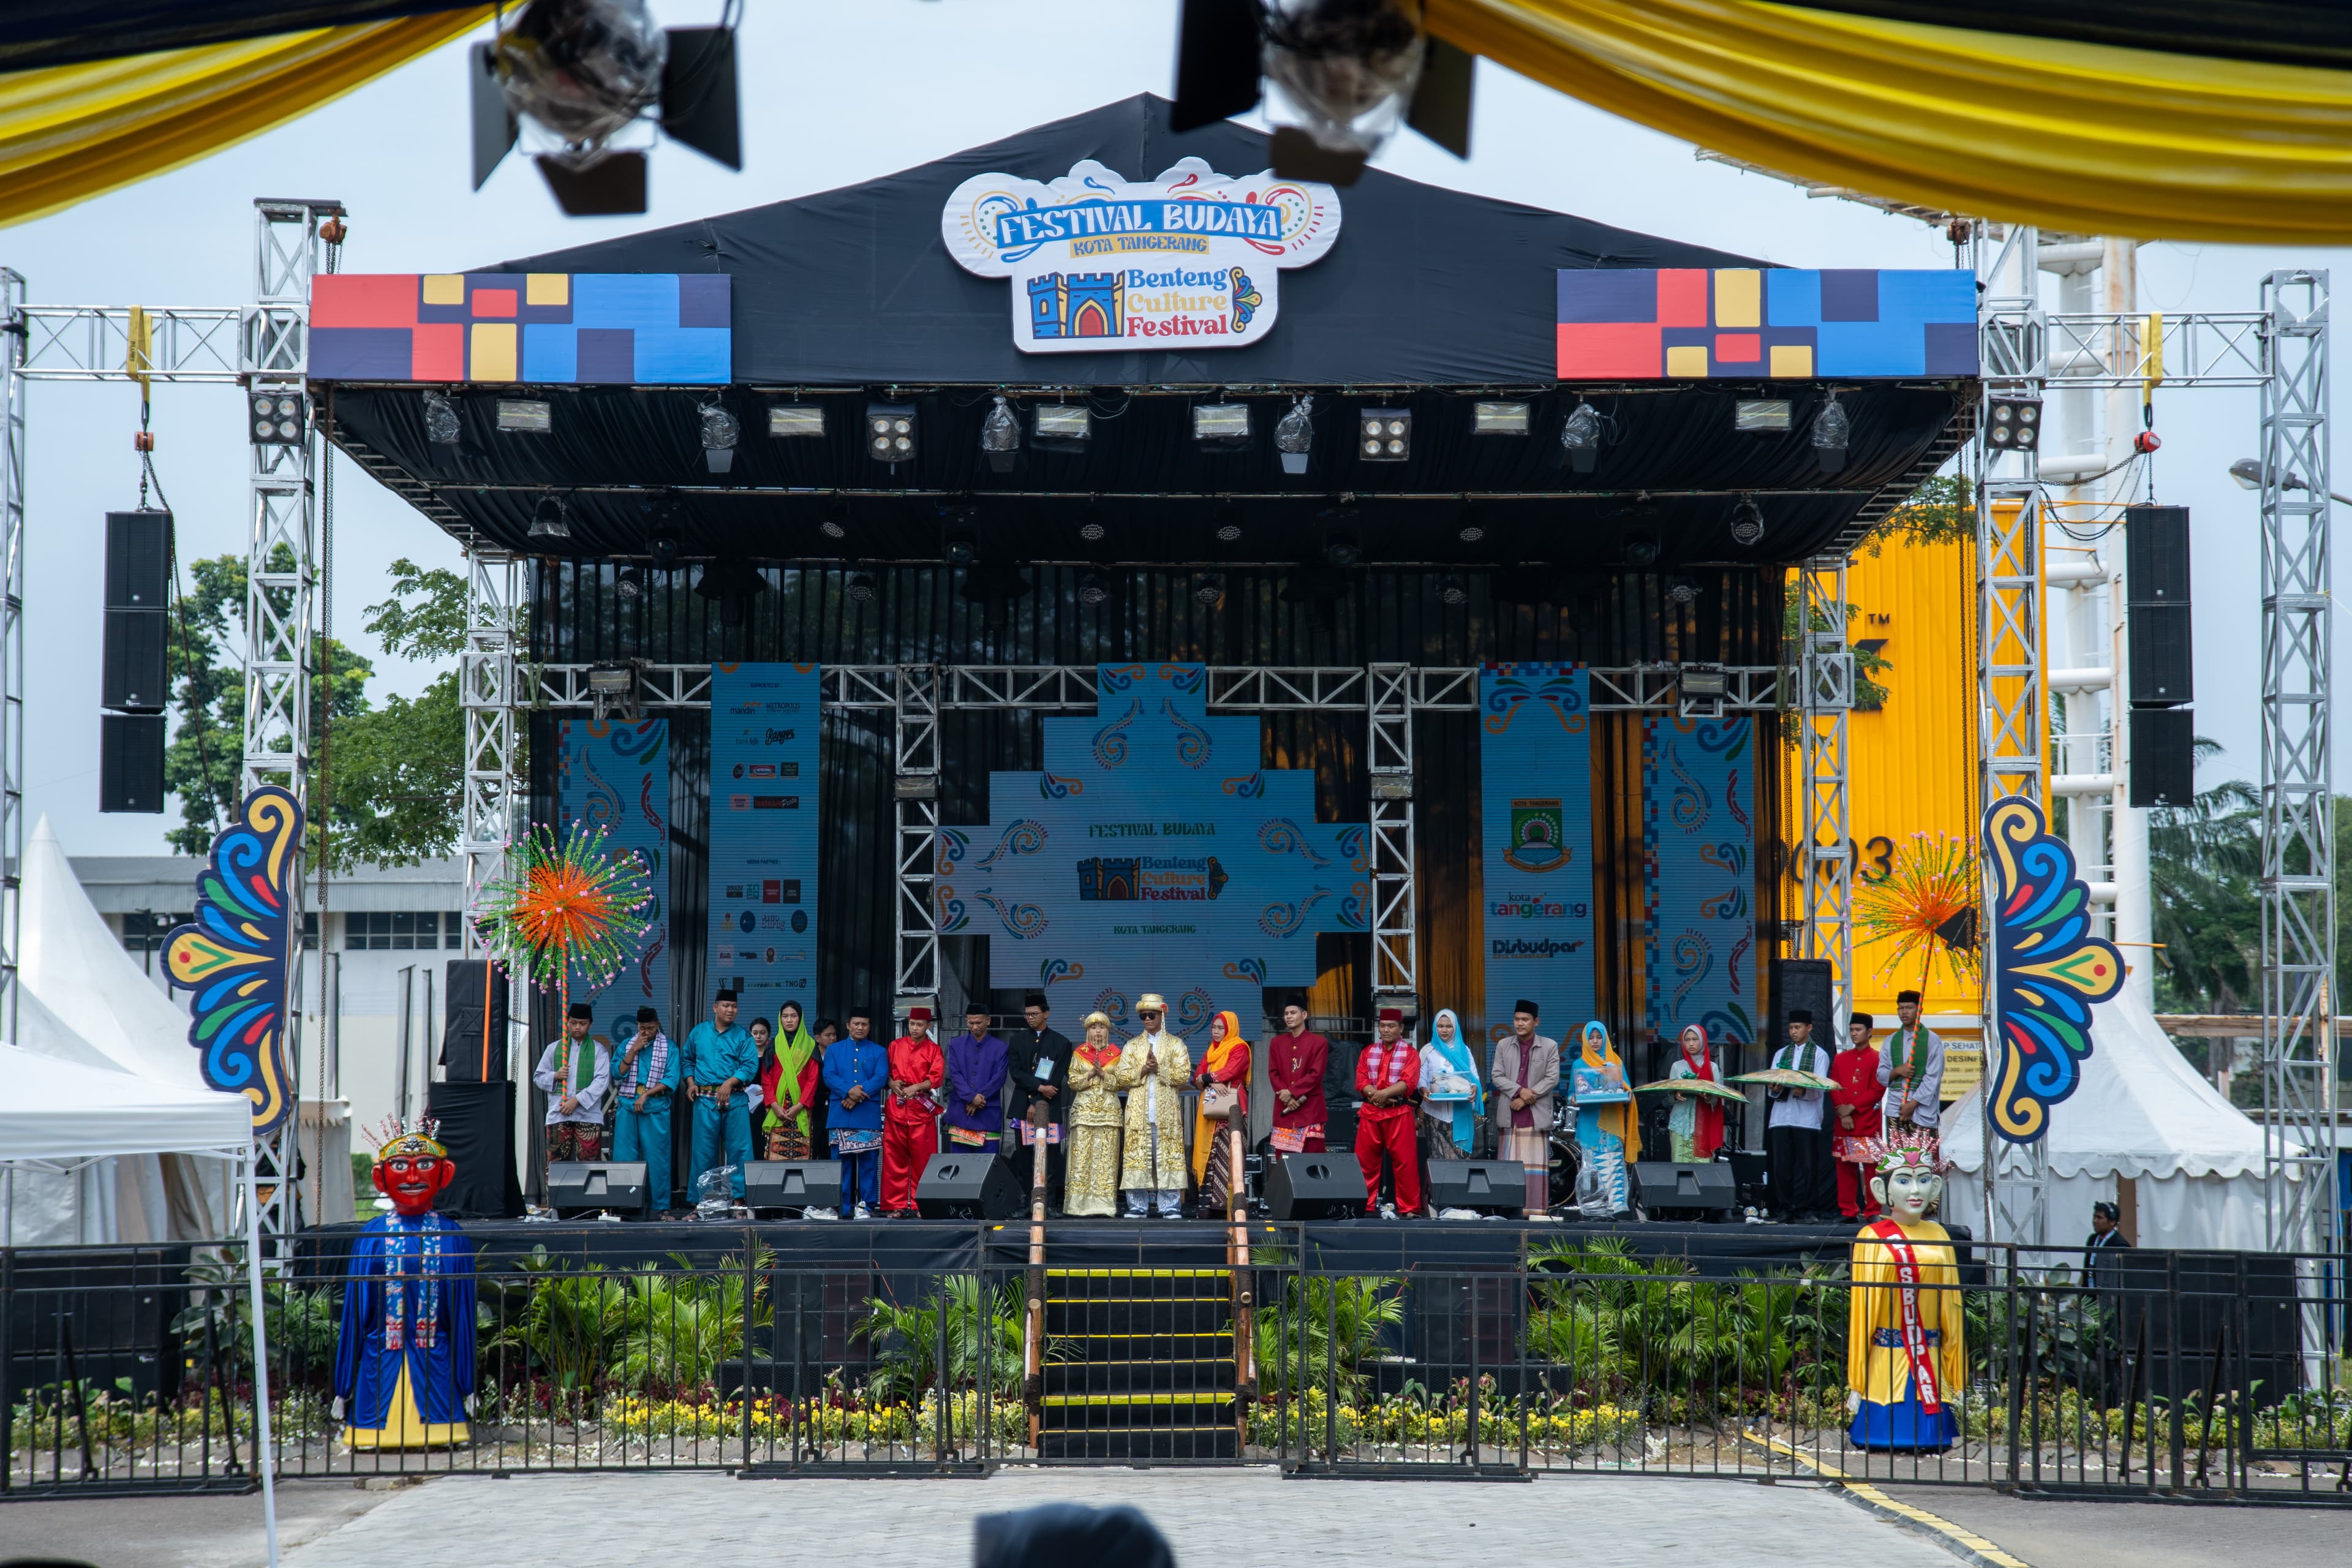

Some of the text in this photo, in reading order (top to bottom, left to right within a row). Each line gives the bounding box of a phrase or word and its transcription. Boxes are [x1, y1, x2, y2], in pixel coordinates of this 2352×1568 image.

[1000, 203, 1278, 244] FESTIVAL BUDAYA
[1074, 235, 1207, 256] KOTA TANGERANG
[1128, 266, 1227, 291] Benteng
[1128, 291, 1228, 313] Culture
[1127, 314, 1229, 337] Festival
[1868, 612, 1890, 624] TM
[730, 706, 755, 715] mandiri
[1089, 823, 1216, 838] FESTIVAL BUDAYA
[1142, 856, 1207, 872] Benteng
[1141, 872, 1207, 886] Culture
[1140, 886, 1207, 901] Festival
[1509, 892, 1531, 902] kota
[1490, 900, 1587, 919] tangerang
[1114, 924, 1196, 935] KOTA TANGERANG
[1493, 938, 1585, 958] Disbudpar
[1887, 1233, 1937, 1404] DISBUDPAR
